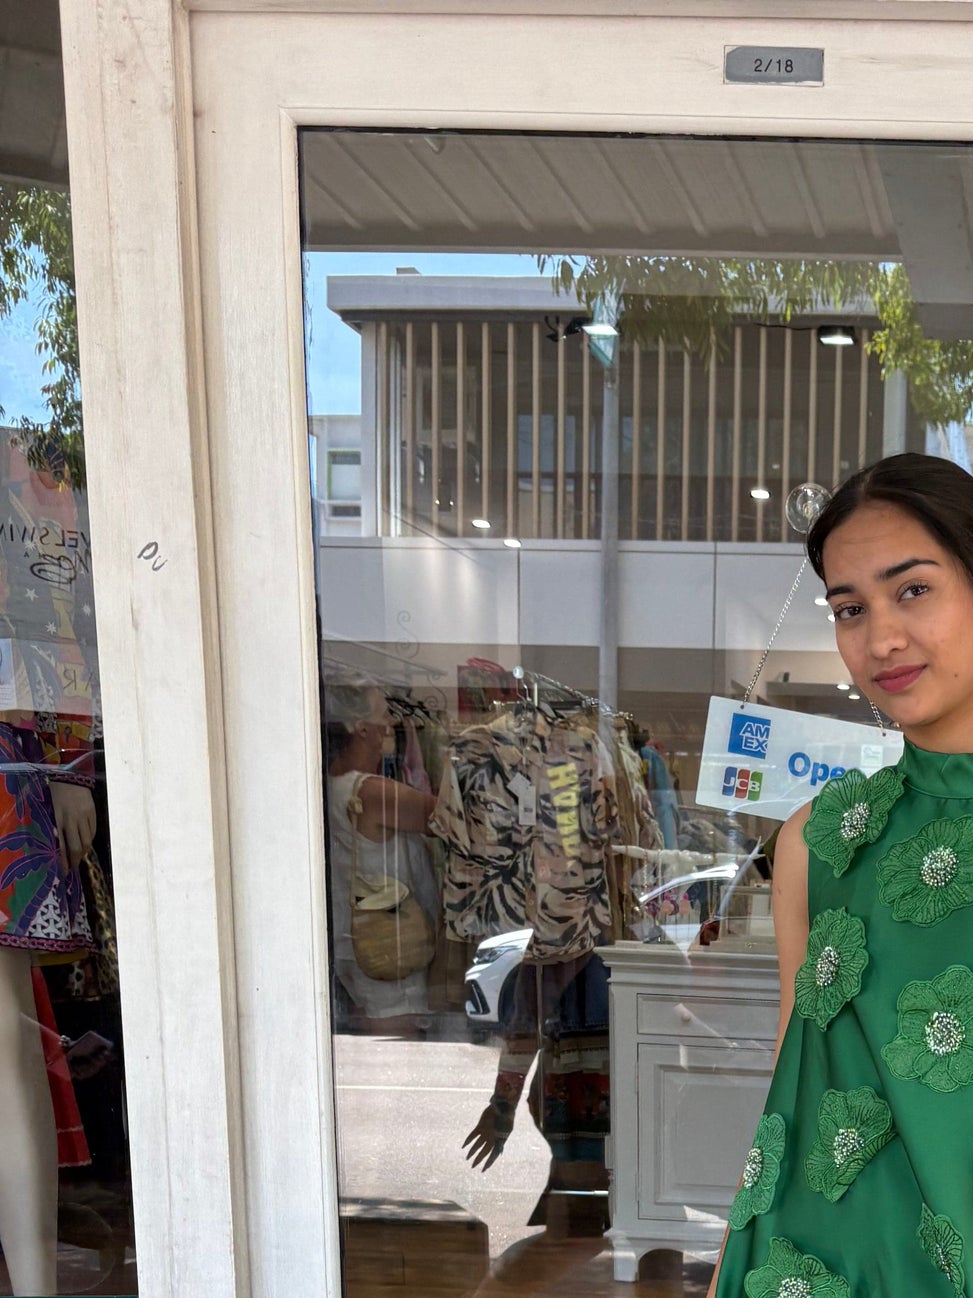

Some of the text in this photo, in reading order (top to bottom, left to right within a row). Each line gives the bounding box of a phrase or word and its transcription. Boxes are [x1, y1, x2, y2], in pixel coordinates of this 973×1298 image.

[754, 58, 794, 73] 2/18
[739, 722, 770, 738] AM
[742, 736, 768, 751] EX
[787, 752, 846, 787] Ope
